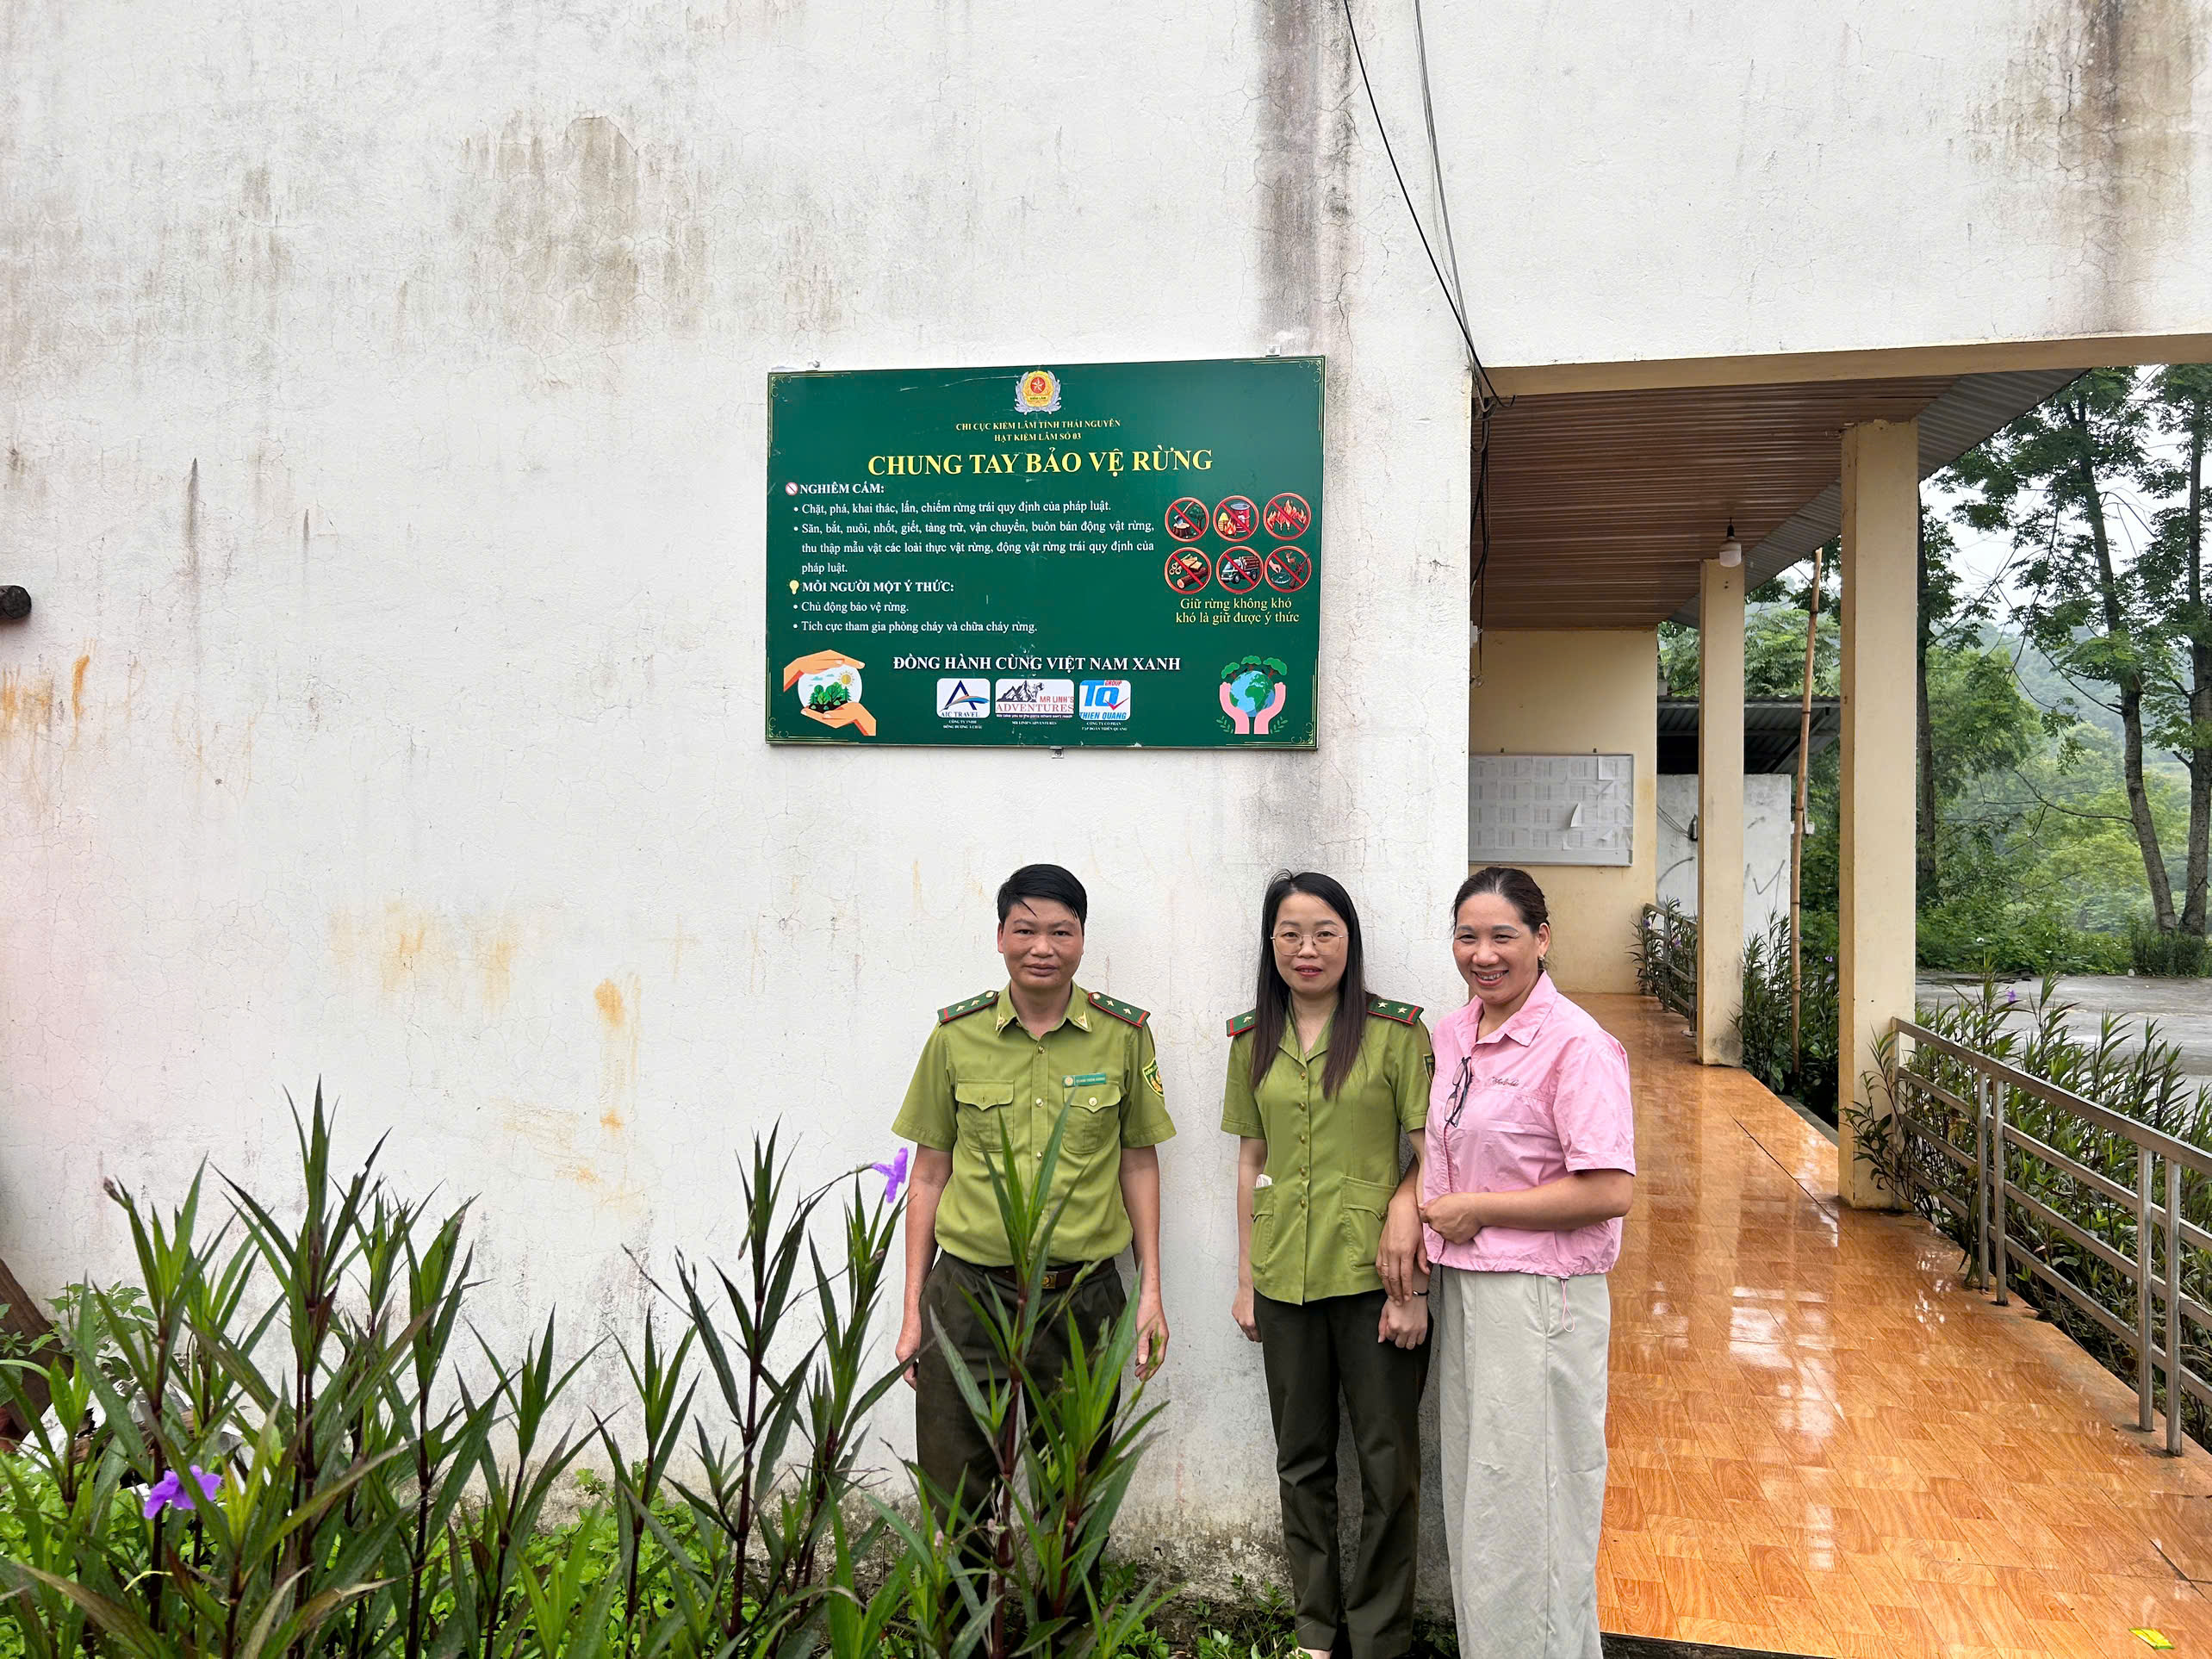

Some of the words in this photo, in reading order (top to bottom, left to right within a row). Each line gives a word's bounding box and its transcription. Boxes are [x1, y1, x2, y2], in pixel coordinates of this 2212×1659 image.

[973, 423, 991, 432] CỤC
[1018, 420, 1036, 429] LÂM
[1085, 419, 1120, 427] NGUYÊN
[995, 434, 1012, 443] HẠT
[1039, 432, 1057, 440] LÂM
[868, 455, 962, 475] CHUNG
[969, 452, 1020, 474] TAY
[1025, 447, 1081, 473] BẢO
[1089, 448, 1124, 476] VỆ
[1132, 444, 1213, 471] RỪNG
[800, 482, 849, 494] NGHIÊM
[853, 481, 884, 494] CẤM:
[802, 504, 827, 515] Chặt,
[830, 504, 849, 516] phá,
[853, 503, 873, 513] khai
[876, 503, 898, 514] thác,
[902, 500, 918, 513] lấn,
[922, 500, 950, 513] chiếm
[954, 502, 976, 514] rừng
[979, 502, 994, 512] trái
[997, 505, 1016, 514] quy
[1018, 501, 1040, 513] định
[1043, 501, 1060, 511] của
[1063, 500, 1087, 513] pháp
[1090, 500, 1110, 513] luật.
[802, 524, 823, 534] Săn,
[826, 521, 843, 534] bắt,
[847, 523, 870, 534] nuôi,
[874, 520, 898, 534] nhốt,
[901, 520, 922, 535] giết,
[925, 523, 946, 535] tàng
[949, 523, 966, 533] trữ,
[970, 522, 987, 533] vận
[991, 519, 1028, 534] chuyển,
[1032, 521, 1056, 531] buôn
[1059, 521, 1077, 531] bán
[1081, 521, 1105, 533] động
[1109, 520, 1124, 532] vật
[1128, 520, 1154, 532] rừng,
[802, 544, 817, 552] thu
[820, 544, 841, 555] thập
[867, 543, 882, 554] vật
[885, 543, 901, 552] các
[904, 542, 922, 552] loài
[925, 543, 947, 554] thực
[950, 542, 965, 554] vật
[968, 542, 993, 554] rừng,
[997, 542, 1021, 554] động
[1024, 542, 1039, 553] vật
[1043, 541, 1066, 554] rừng
[1069, 541, 1085, 551] trái
[1089, 544, 1108, 553] quy
[1111, 540, 1133, 552] định
[1137, 541, 1153, 550] của
[802, 562, 824, 575] pháp
[828, 562, 848, 574] luật.
[830, 580, 870, 592] NGƯỜI
[873, 581, 901, 593] MỘT
[904, 580, 912, 592] Ý
[916, 580, 954, 592] THỨC:
[801, 601, 821, 611] Chủ
[823, 601, 848, 613] động
[850, 601, 867, 611] bảo
[870, 602, 881, 613] vệ
[884, 602, 909, 613] rừng.
[1181, 598, 1202, 609] Giữ
[1205, 599, 1230, 612] rừng
[1233, 598, 1267, 611] không
[1271, 598, 1291, 608] khó
[1177, 612, 1196, 623] khó
[1213, 612, 1231, 625] giữ
[1233, 612, 1261, 624] được
[1264, 612, 1271, 624] ý
[1275, 612, 1299, 622] thức
[801, 621, 823, 631] Tích
[825, 624, 842, 632] cực
[845, 621, 868, 631] tham
[872, 621, 886, 633] gia
[889, 621, 918, 633] phòng
[921, 621, 943, 633] cháy
[947, 621, 958, 631] và
[960, 621, 984, 631] chữa
[986, 621, 1009, 633] cháy
[1012, 621, 1037, 633] rừng.
[893, 653, 940, 669] ĐỒNG
[945, 655, 991, 669] HÀNH
[996, 654, 1042, 670] CÙNG
[1047, 656, 1085, 673] VIỆT
[1090, 658, 1128, 670] NAM
[1133, 657, 1180, 670] XANH
[997, 704, 1074, 712] ADVENTURES
